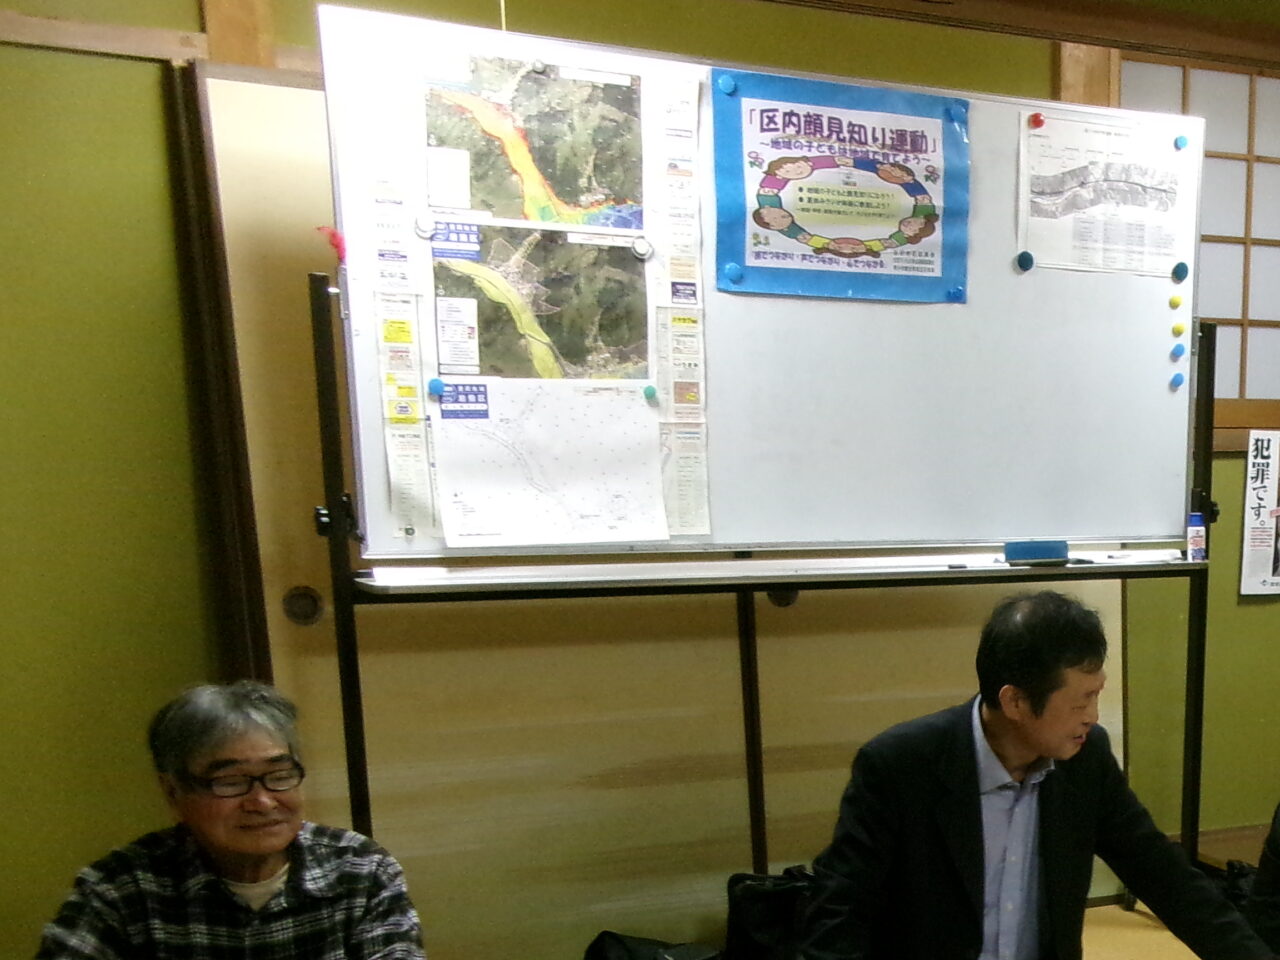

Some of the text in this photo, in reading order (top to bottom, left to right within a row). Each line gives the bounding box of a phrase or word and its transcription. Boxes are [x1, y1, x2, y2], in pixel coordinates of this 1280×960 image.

[749, 107, 938, 154] 「区内顔見知り運動」
[1250, 437, 1272, 527] 犯罪です。
